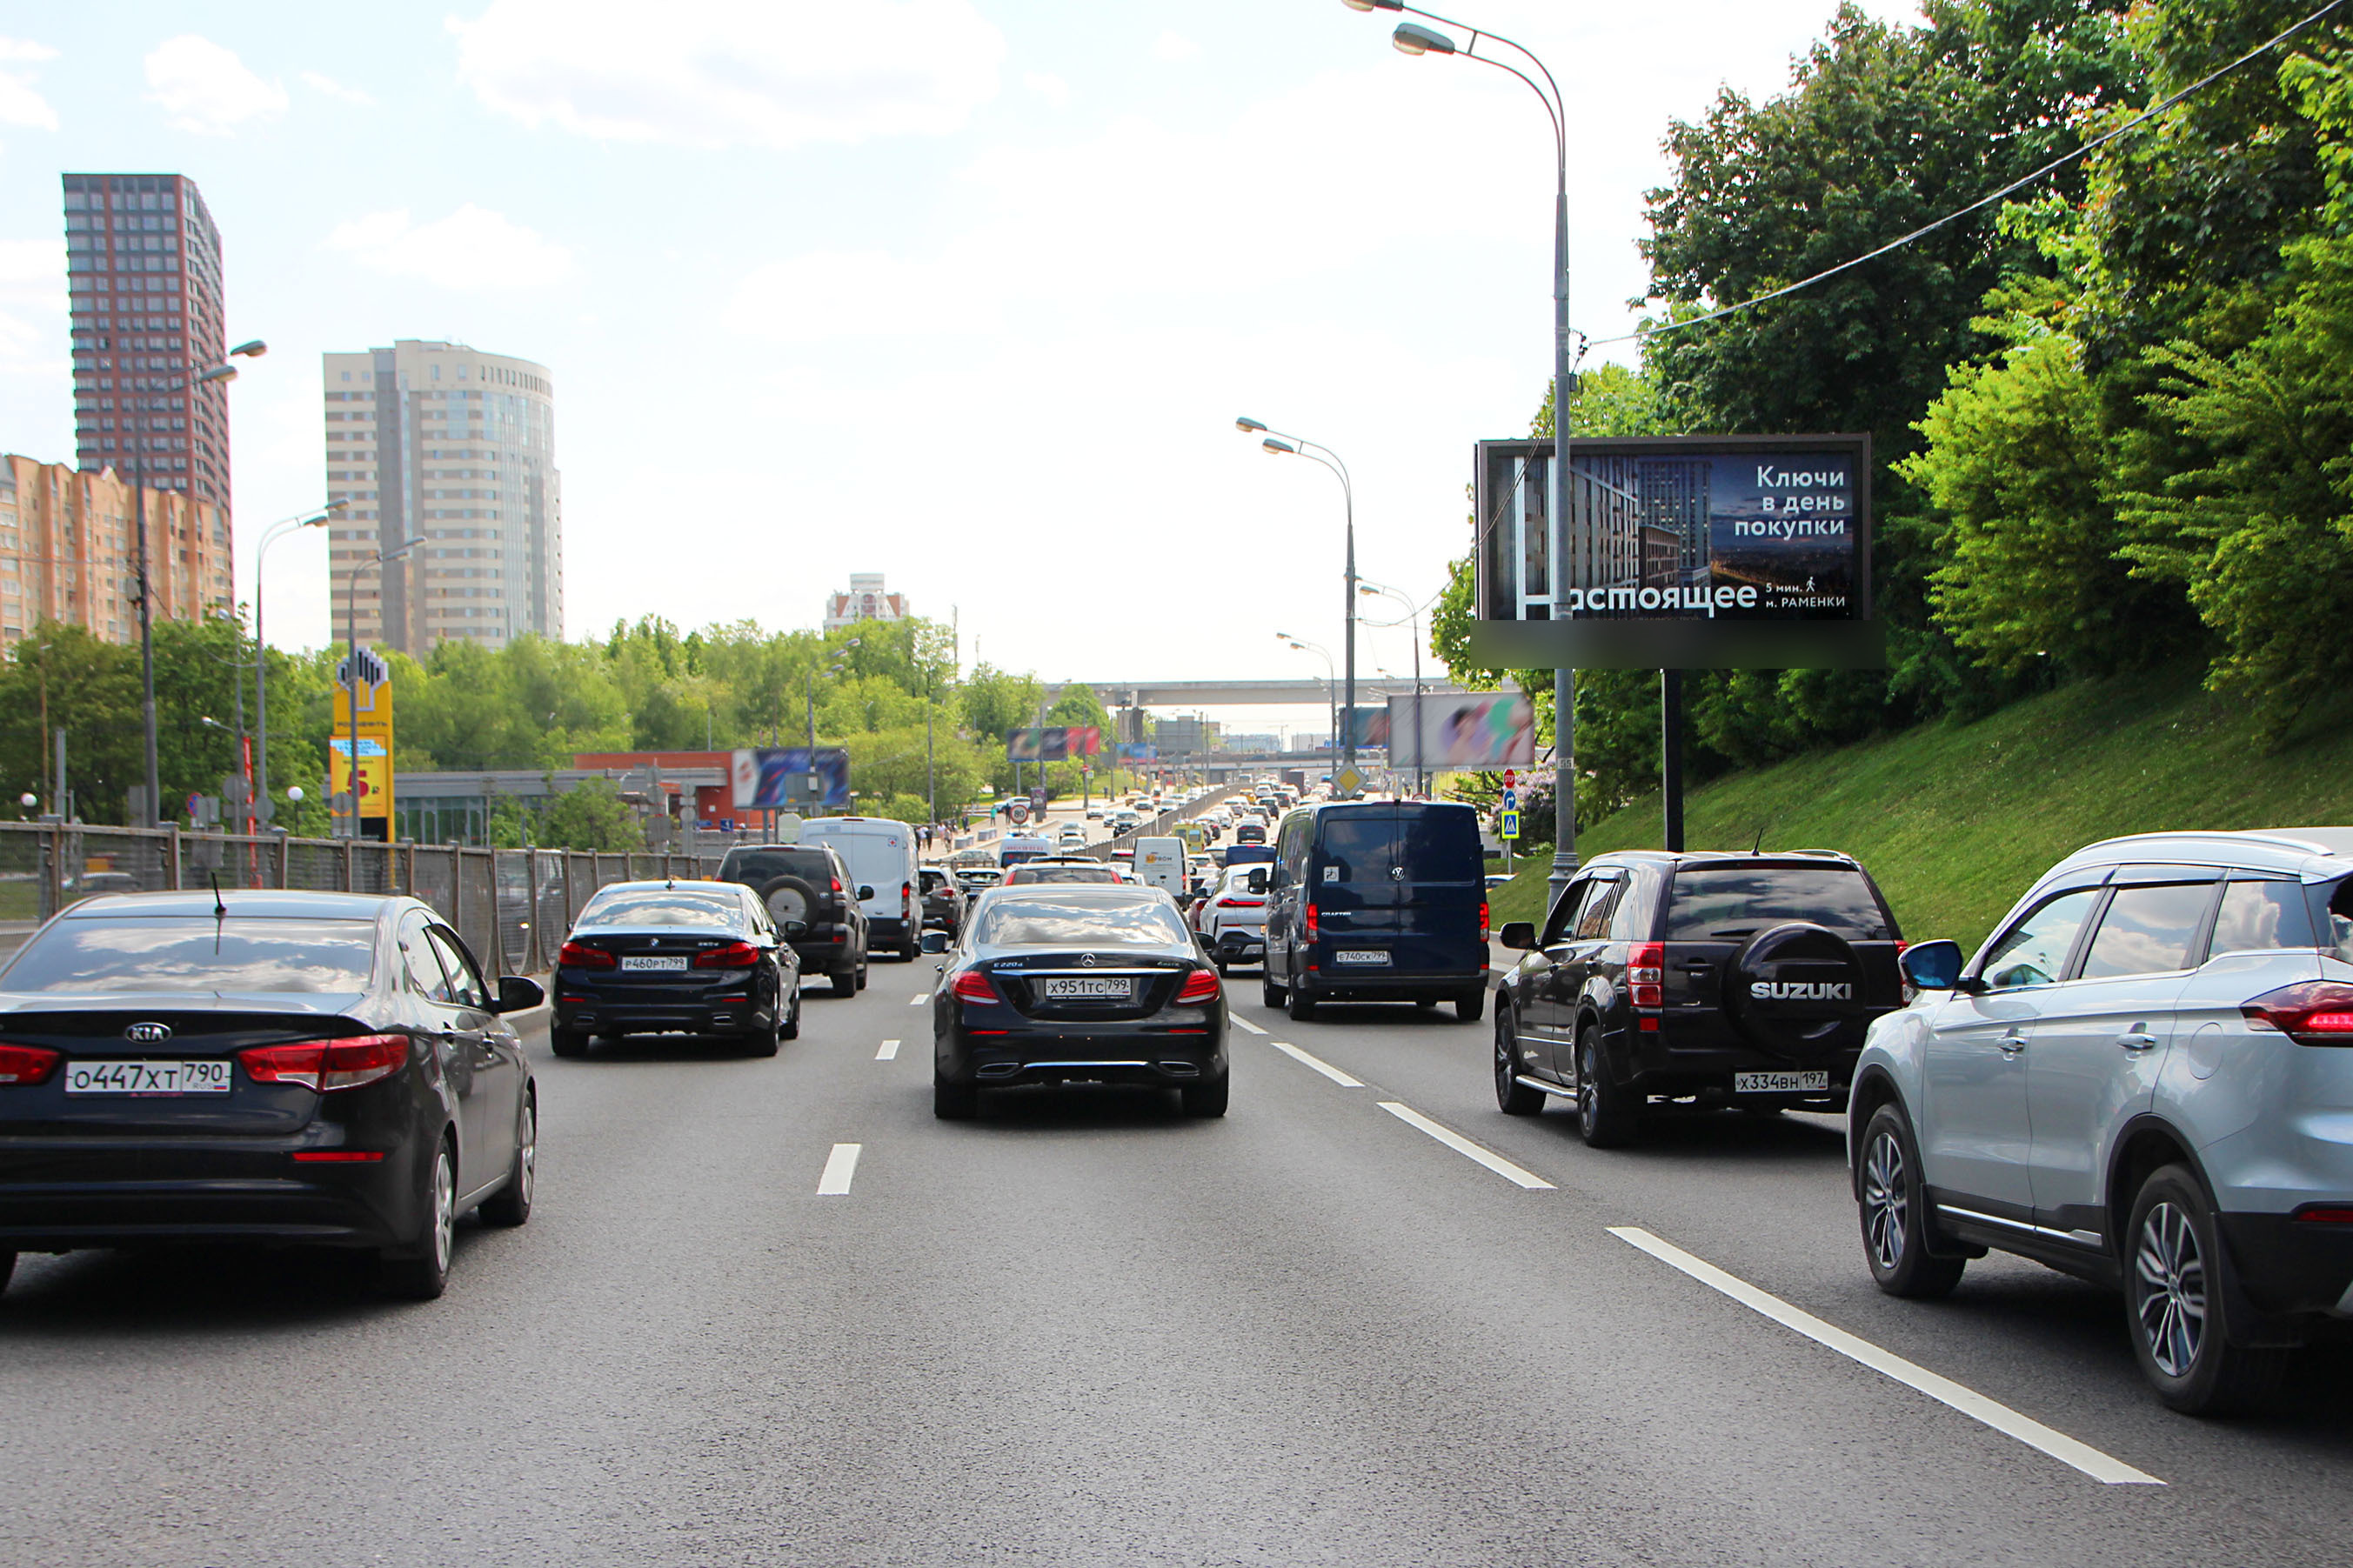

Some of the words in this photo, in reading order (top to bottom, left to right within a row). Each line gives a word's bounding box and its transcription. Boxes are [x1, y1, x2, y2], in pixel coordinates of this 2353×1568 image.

[1757, 465, 1844, 487] Ключи
[1762, 496, 1775, 511] в
[1783, 496, 1845, 514] день
[1735, 520, 1844, 541] покупки
[1765, 582, 1773, 592] 5
[1781, 597, 1845, 607] РАМЕНКИ
[1013, 810, 1025, 818] 80
[625, 958, 666, 969] Р460РТ
[1050, 980, 1104, 993] Х951ТС
[1106, 979, 1127, 990] 799
[1750, 982, 1852, 1000] SUZUKI
[130, 1026, 165, 1041] KIA
[74, 1065, 178, 1089] О447ХТ
[184, 1064, 223, 1082] 790
[1740, 1074, 1799, 1090] Х334ВН
[1802, 1072, 1824, 1084] 197
